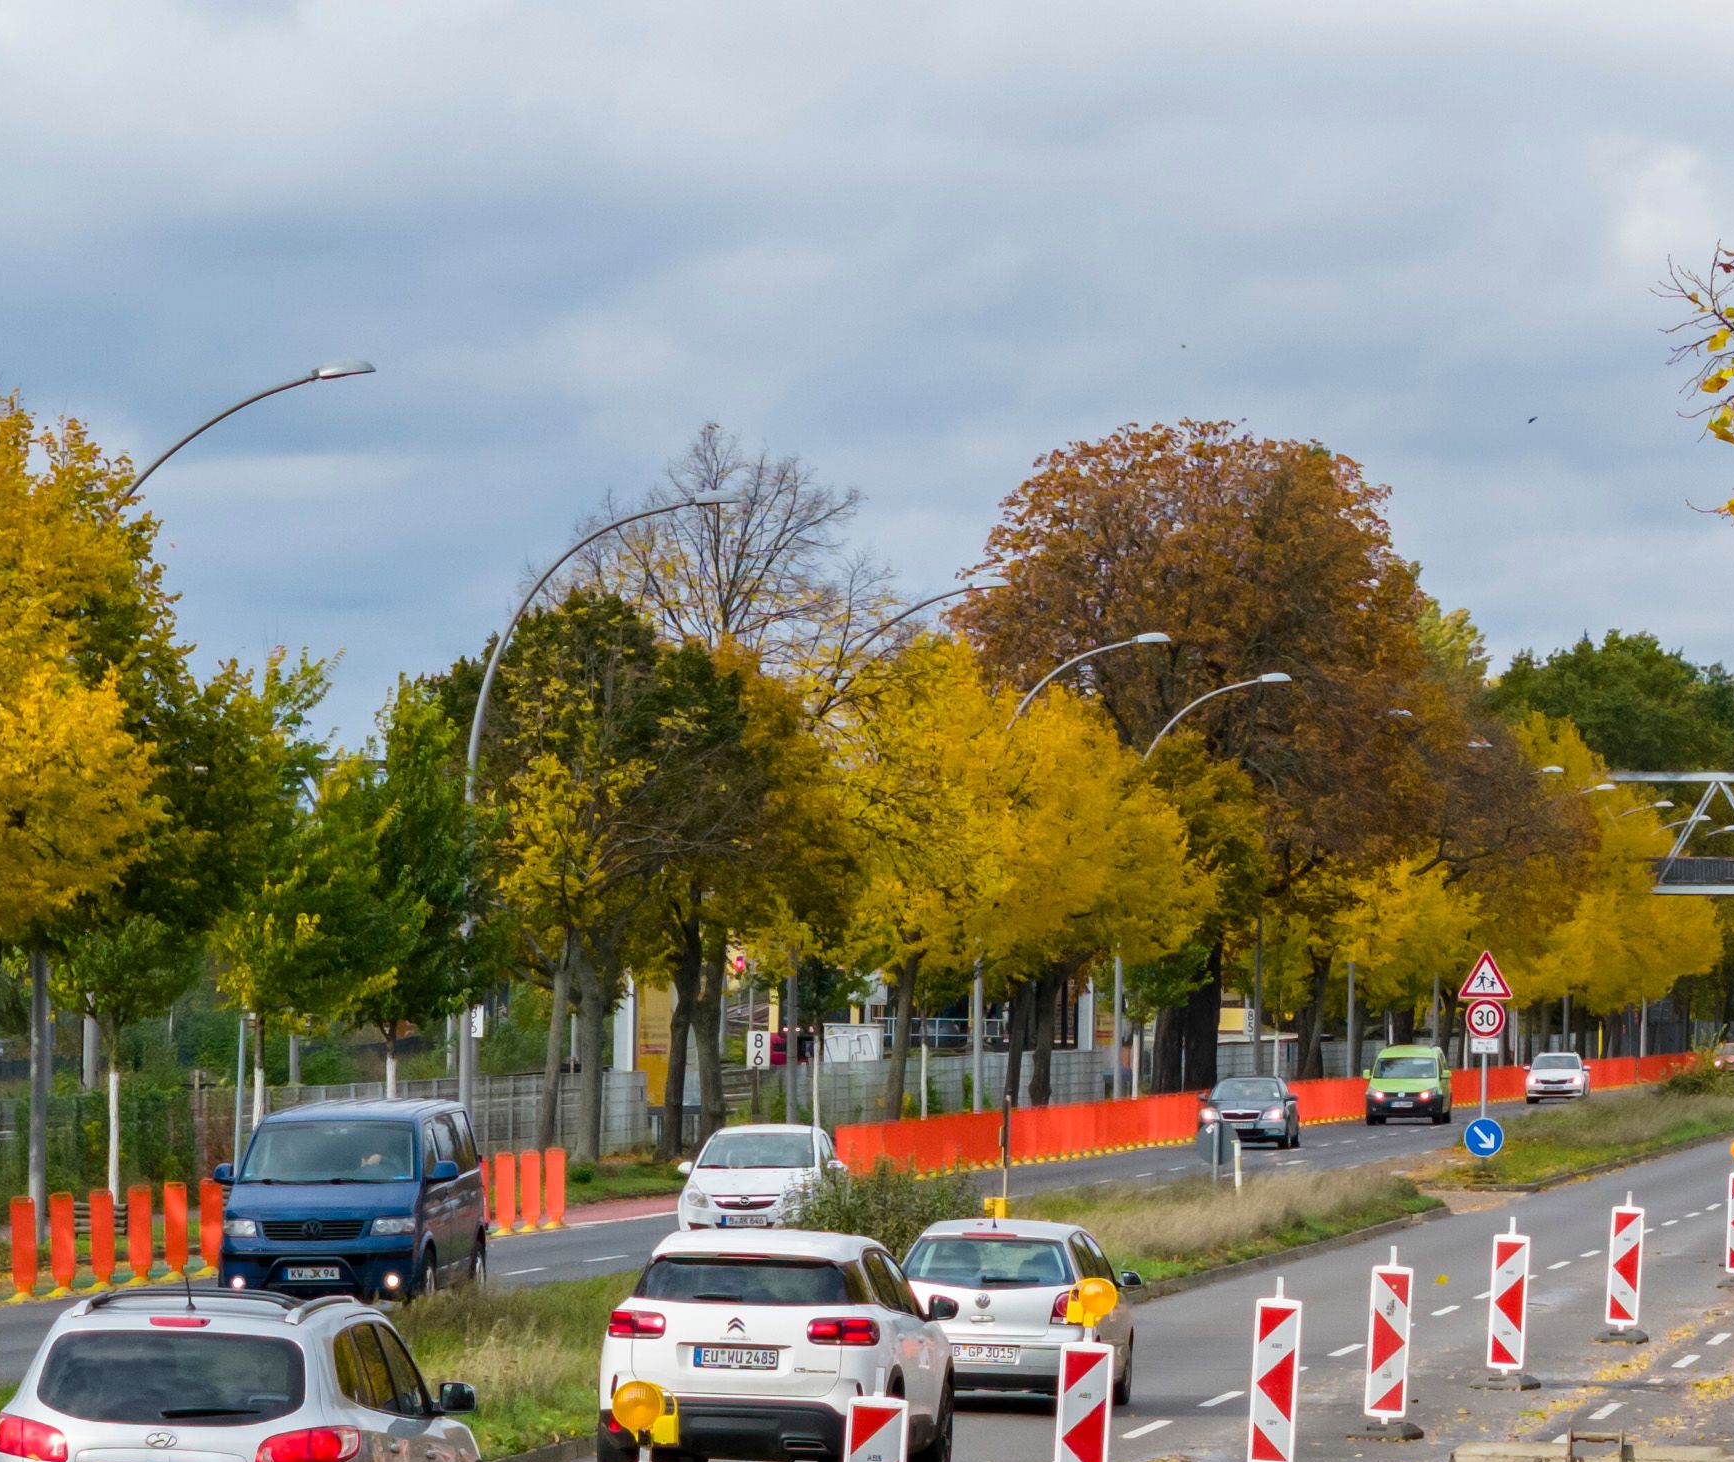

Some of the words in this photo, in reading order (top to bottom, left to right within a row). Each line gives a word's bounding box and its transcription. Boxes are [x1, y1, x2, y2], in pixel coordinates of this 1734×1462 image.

[1475, 1010, 1496, 1027] 30
[754, 1033, 764, 1049] 8
[753, 1050, 764, 1066] 6
[702, 1349, 719, 1363] EU
[727, 1350, 743, 1364] WU
[746, 1351, 777, 1365] 2485
[953, 1346, 961, 1357] B
[968, 1346, 983, 1358] GP
[986, 1347, 1014, 1359] 3015
